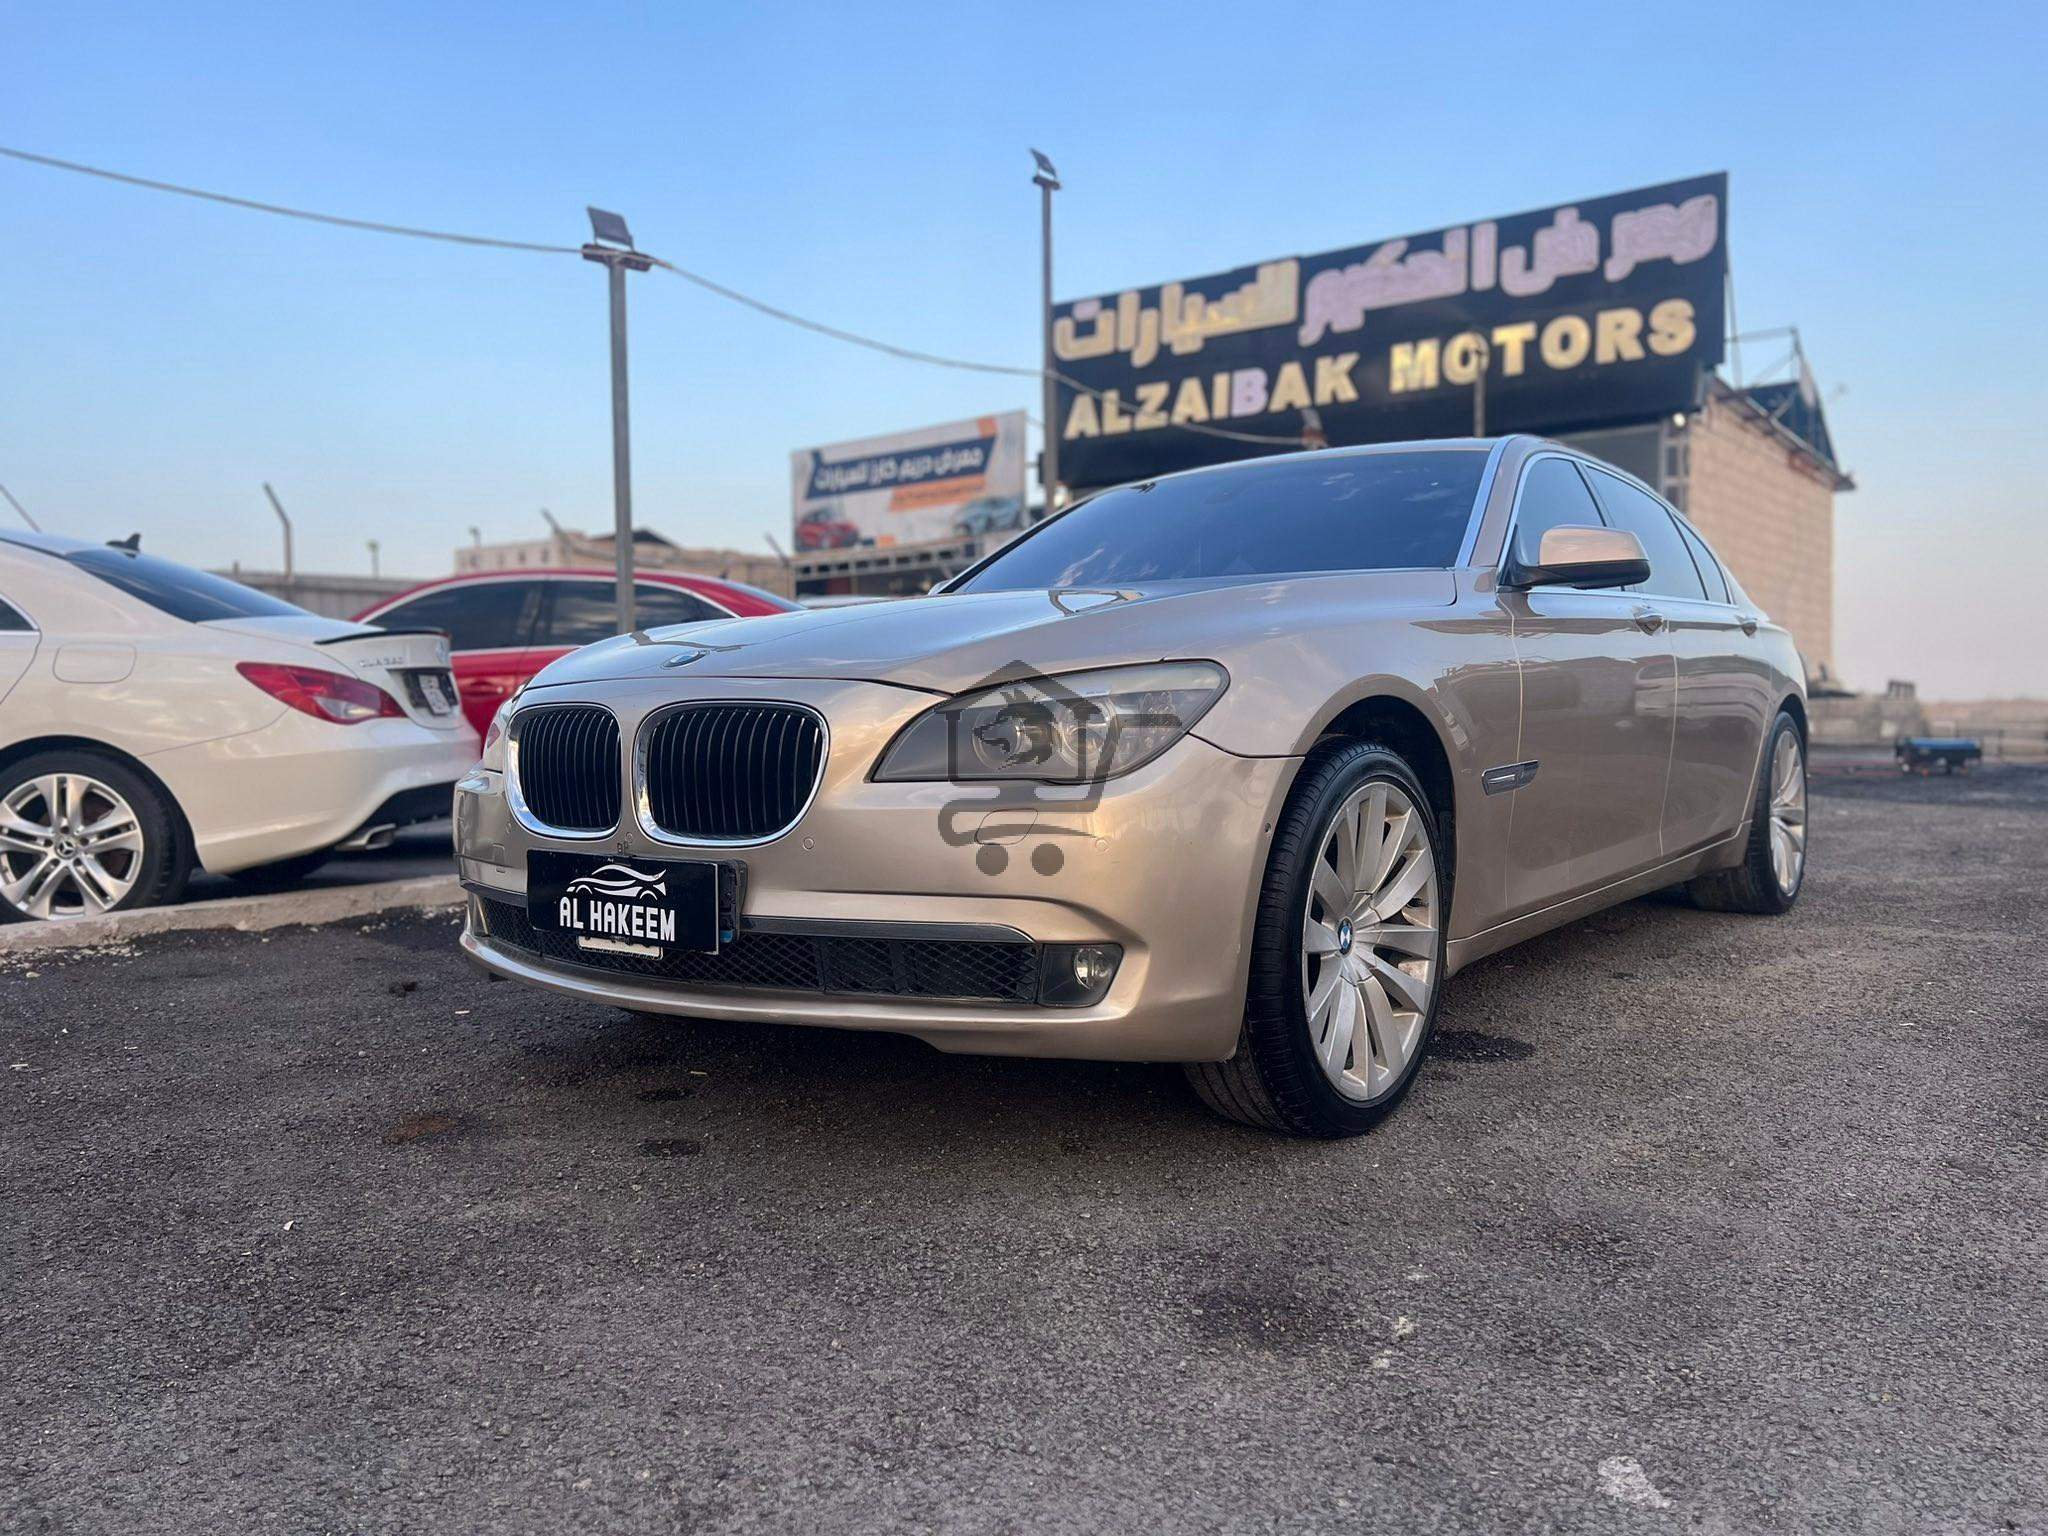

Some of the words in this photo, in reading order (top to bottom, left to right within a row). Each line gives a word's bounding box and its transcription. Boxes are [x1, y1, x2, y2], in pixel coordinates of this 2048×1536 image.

[1297, 221, 1498, 346] الحكيم
[1499, 193, 1718, 298] معرض
[1064, 352, 1360, 440] ALZAIBAK
[1389, 299, 1697, 394] MOTORS
[559, 896, 584, 929] AL
[590, 900, 676, 942] HAKEEM
